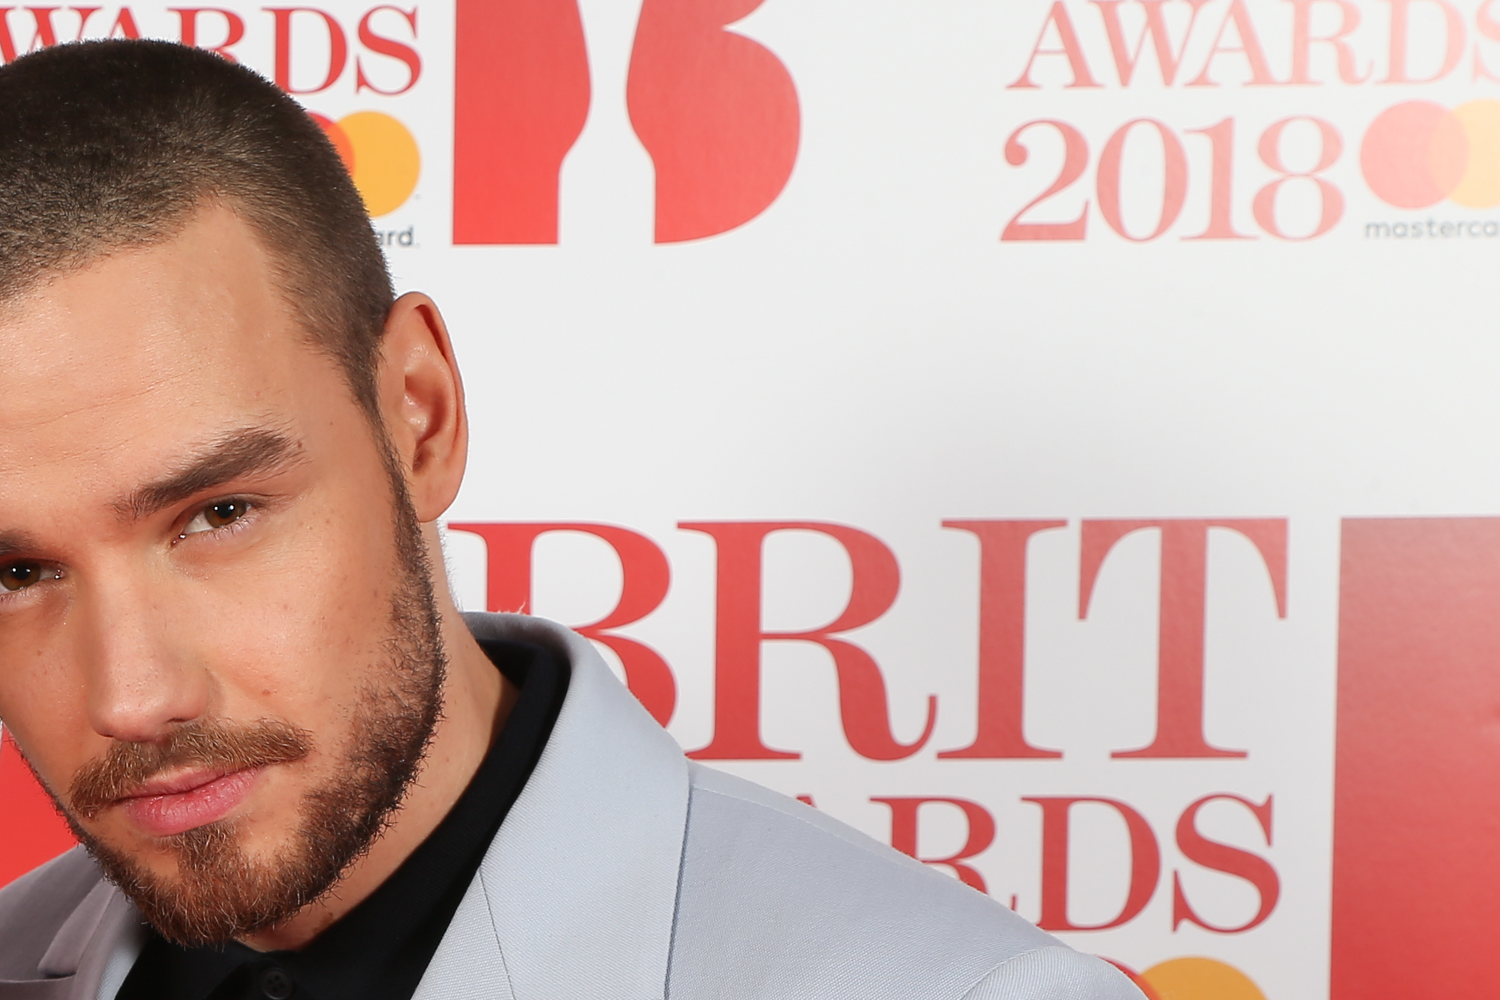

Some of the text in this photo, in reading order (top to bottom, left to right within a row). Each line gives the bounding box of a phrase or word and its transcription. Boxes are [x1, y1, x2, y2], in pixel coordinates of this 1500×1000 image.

[999, 114, 1346, 243] 2018
[1365, 216, 1500, 238] masterca
[797, 792, 1282, 935] RDS
